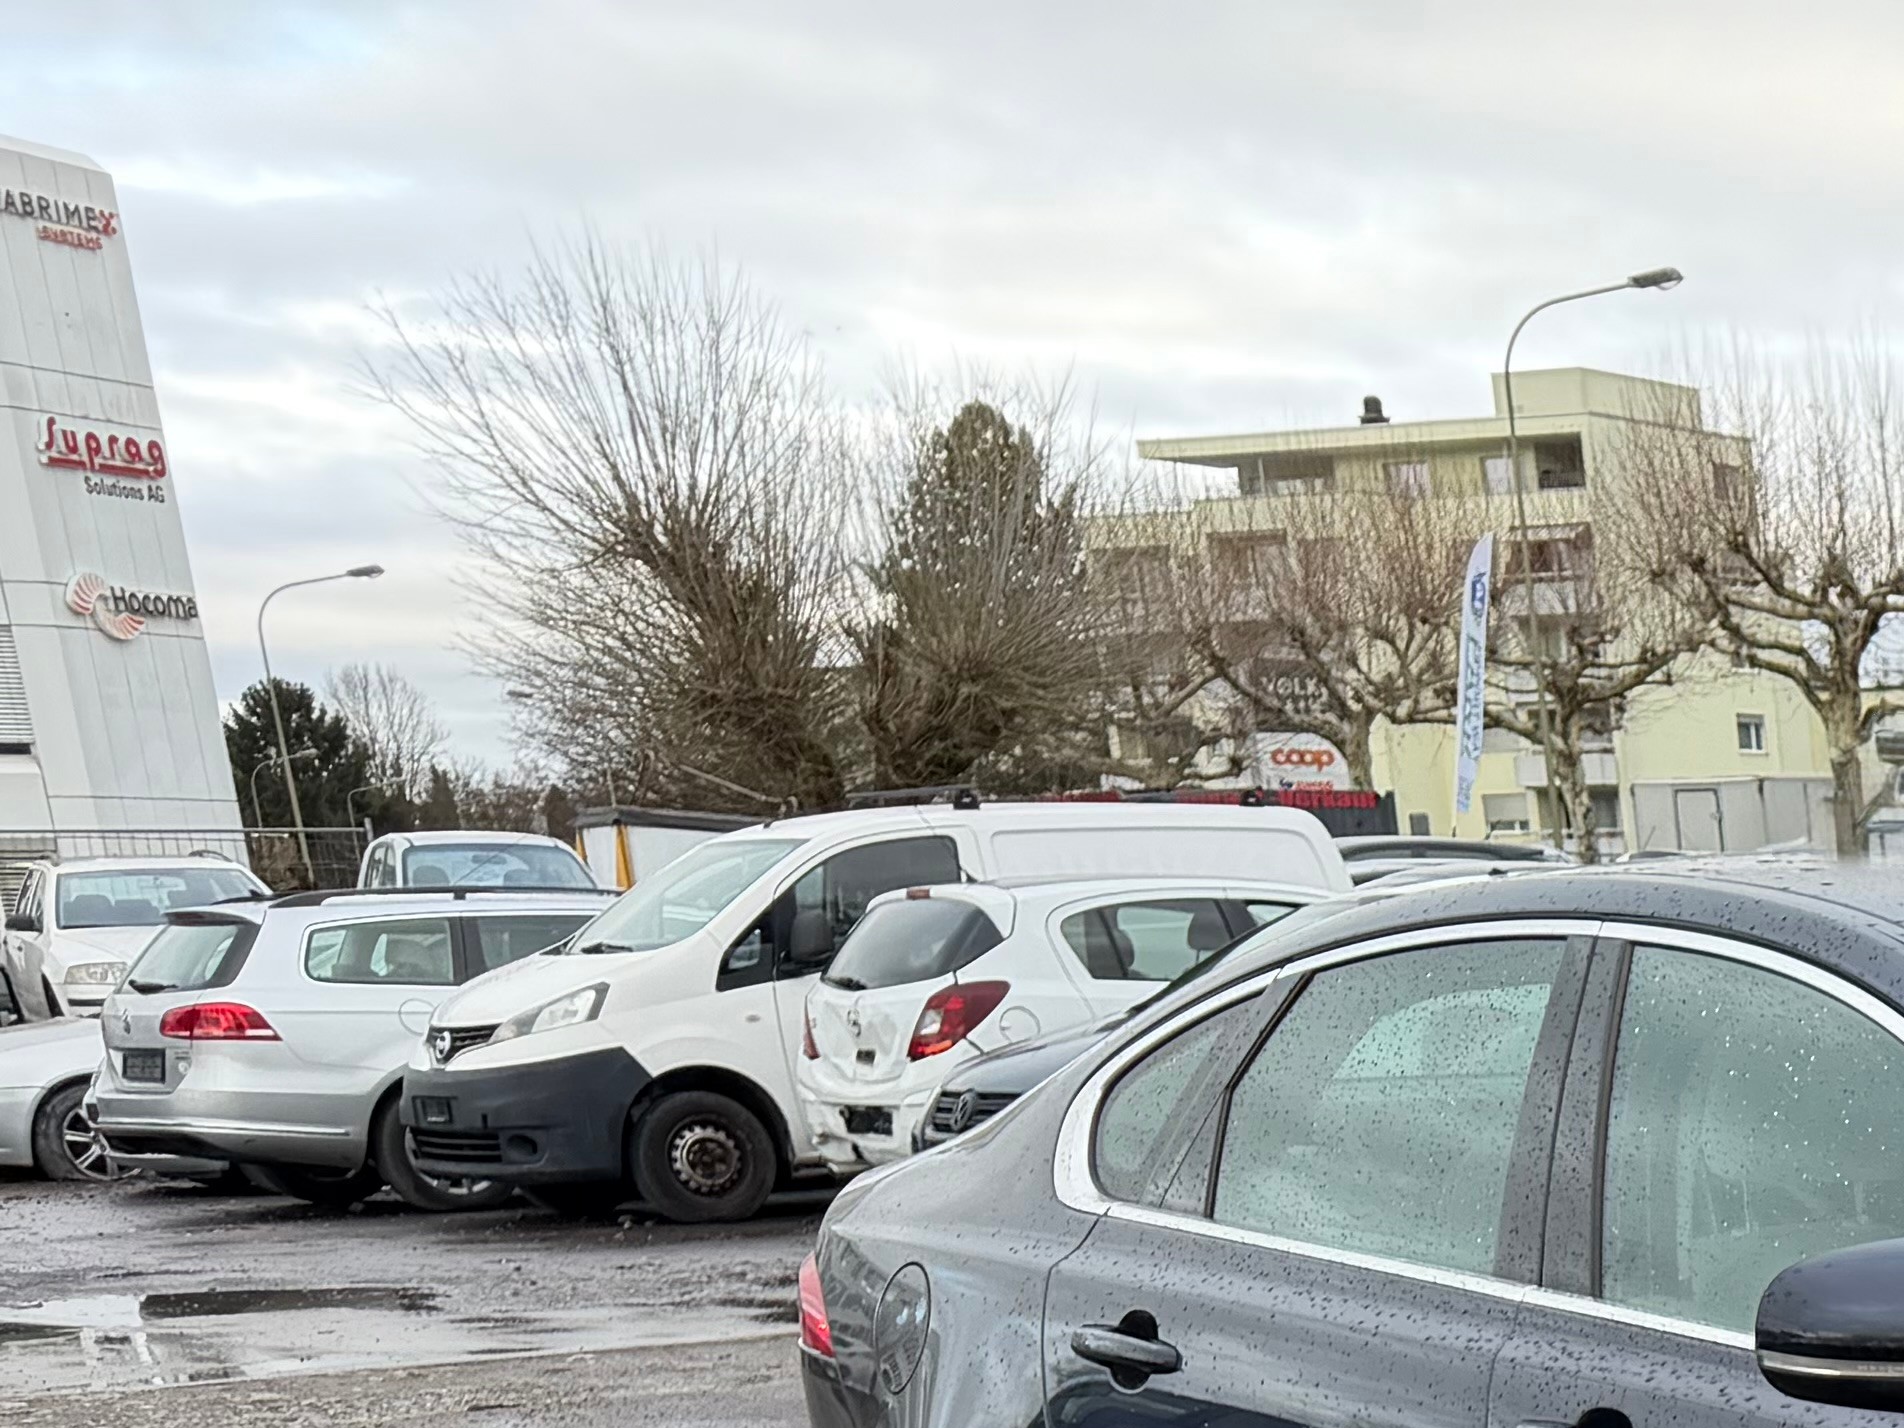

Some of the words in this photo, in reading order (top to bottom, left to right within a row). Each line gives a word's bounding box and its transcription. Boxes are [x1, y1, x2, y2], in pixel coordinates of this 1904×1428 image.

[0, 188, 118, 237] ABRIMEX
[84, 475, 145, 501] Solutions
[147, 484, 165, 503] AG
[110, 586, 199, 619] Hocoma
[1271, 747, 1335, 772] coop
